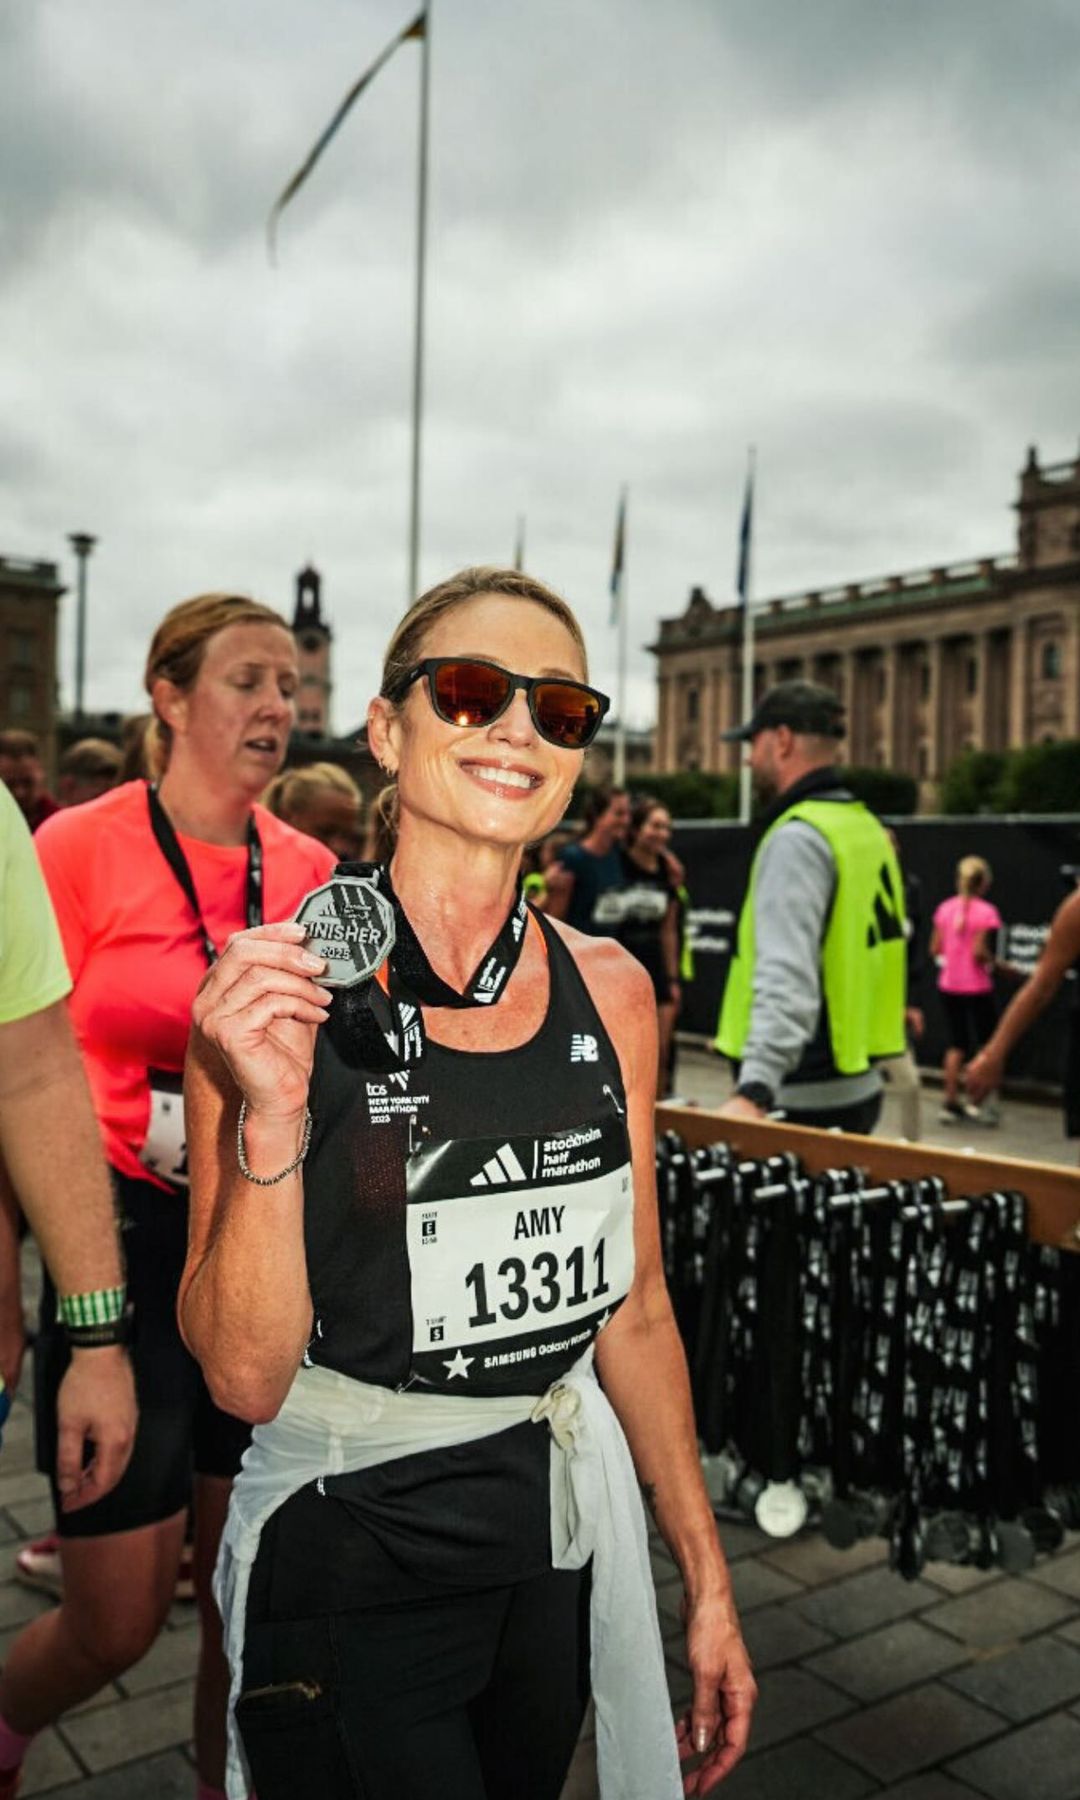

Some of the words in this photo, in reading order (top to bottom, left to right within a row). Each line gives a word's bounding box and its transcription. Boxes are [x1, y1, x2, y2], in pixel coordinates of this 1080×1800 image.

[303, 921, 381, 944] FINISHER
[320, 946, 351, 961] 2025
[368, 1098, 389, 1106] NEW
[390, 1096, 412, 1105] YORK
[412, 1095, 430, 1105] CITY
[369, 1105, 418, 1114] MARATHON
[543, 1128, 602, 1152] stockholm
[541, 1156, 601, 1178] marathon
[543, 1151, 570, 1166] half
[514, 1205, 565, 1240] AMY
[465, 1237, 609, 1328] 13311
[484, 1347, 537, 1368] SAMSUNG
[539, 1340, 570, 1356] Galaxy
